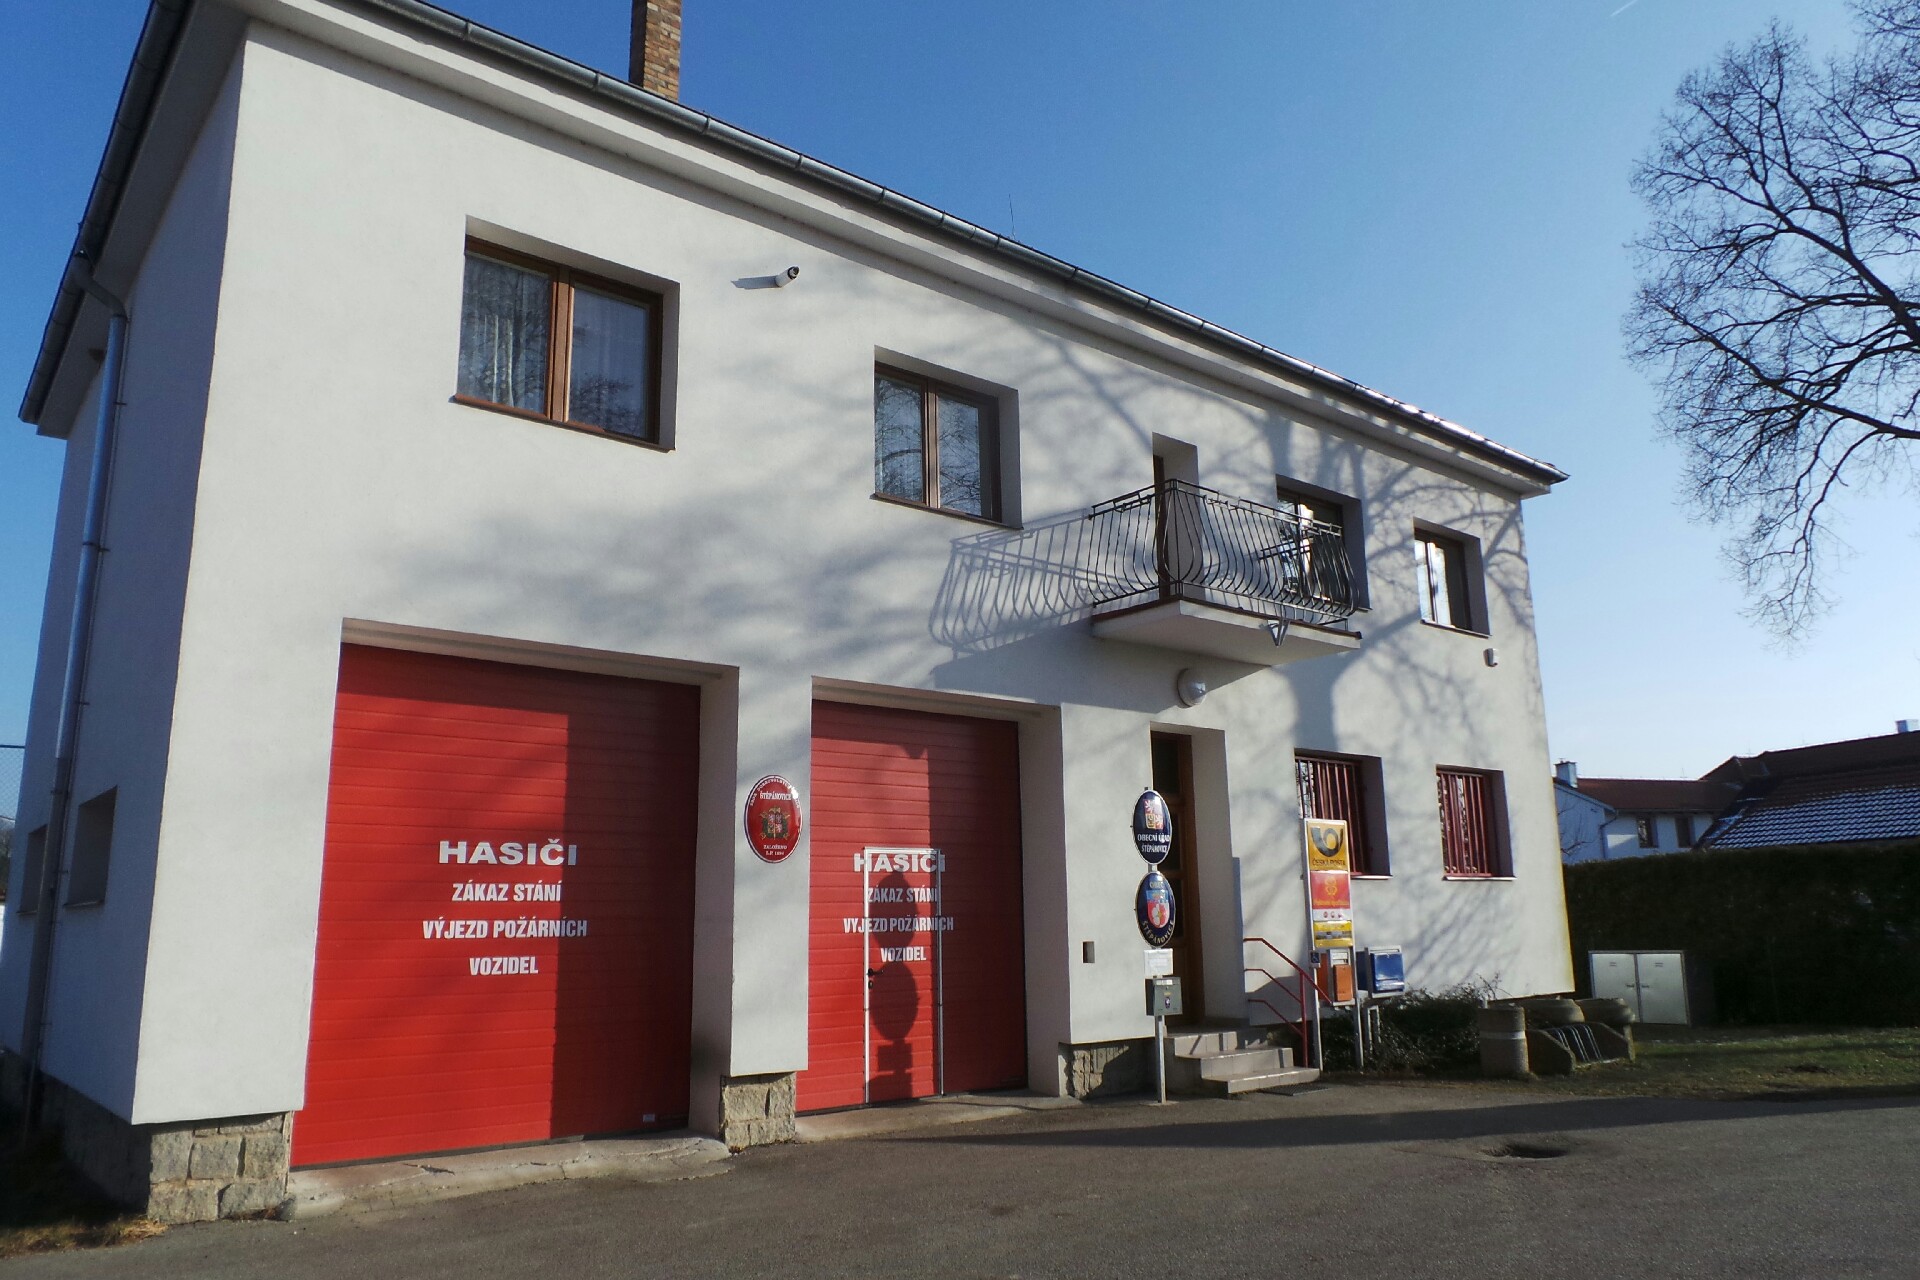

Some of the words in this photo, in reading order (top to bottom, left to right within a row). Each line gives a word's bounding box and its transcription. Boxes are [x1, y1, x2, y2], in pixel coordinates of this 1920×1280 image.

[1137, 832, 1158, 841] OBECNÍ
[438, 838, 577, 866] HASIČI
[1141, 843, 1168, 853] ŠTĚPÁNOVICE
[451, 879, 509, 902] ZÁKAZ
[513, 879, 563, 902] STÁNÍ
[867, 885, 903, 903] ZÁKAZ
[422, 916, 489, 939] VÝJEZD
[492, 916, 588, 938] POŽÁRNÍCH
[889, 914, 954, 932] POŽÁRNÍCH
[880, 946, 927, 963] VOZIDEL
[469, 956, 539, 976] VOZIDEL
